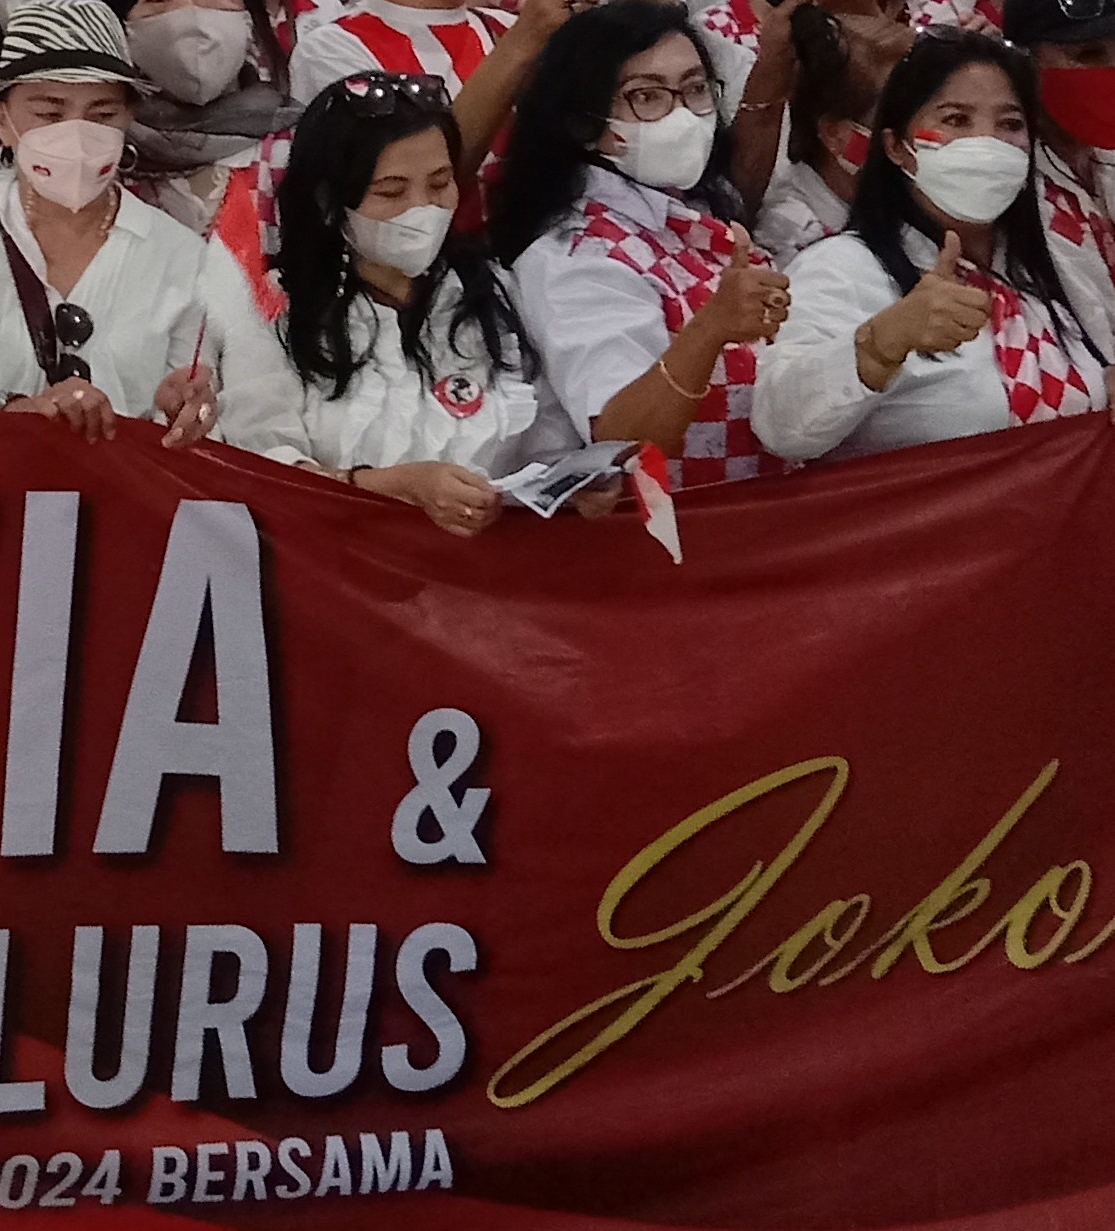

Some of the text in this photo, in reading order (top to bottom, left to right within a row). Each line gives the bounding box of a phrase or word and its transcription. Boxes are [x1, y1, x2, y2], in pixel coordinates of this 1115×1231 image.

[391, 708, 491, 866] &
[487, 755, 1115, 1109] Joko
[147, 1129, 454, 1204] BERSAMA
